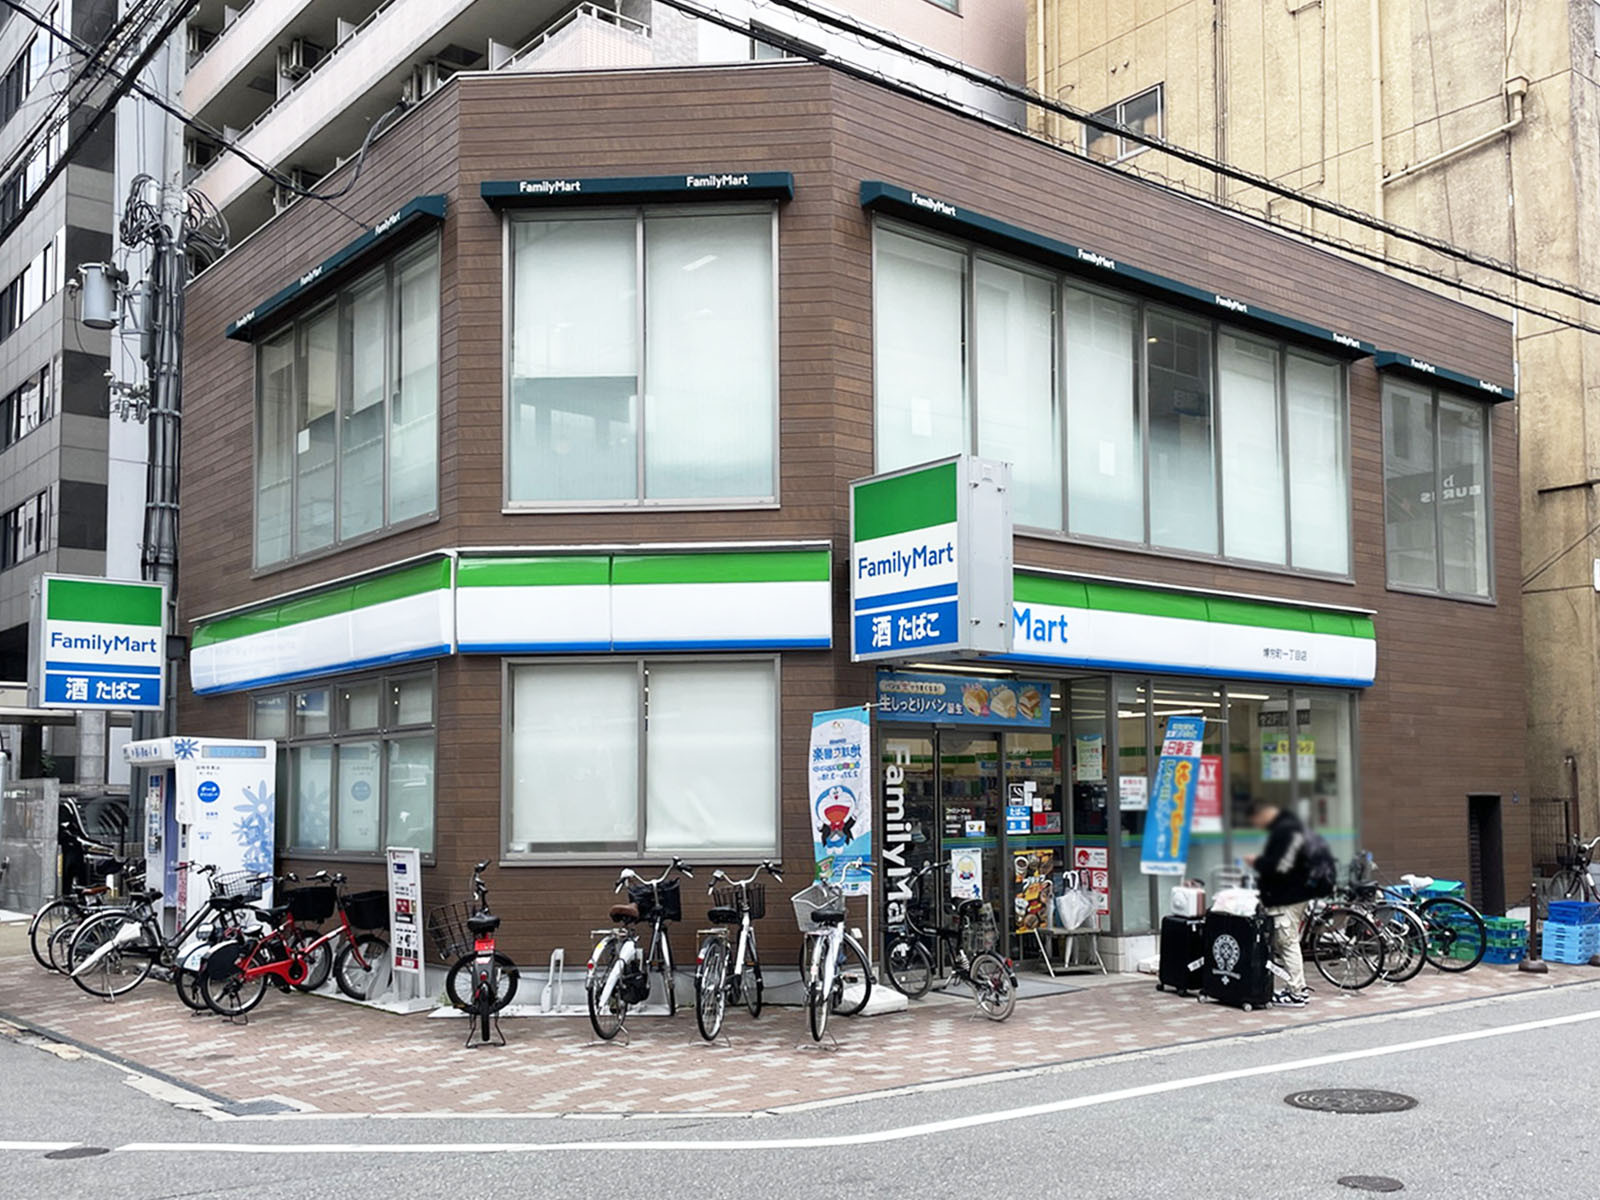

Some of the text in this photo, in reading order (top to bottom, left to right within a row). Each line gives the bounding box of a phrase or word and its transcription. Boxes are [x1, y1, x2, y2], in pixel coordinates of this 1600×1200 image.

[520, 181, 581, 194] FamilyMart
[686, 174, 749, 188] FamilyMart
[911, 193, 957, 217] FamilyMart
[1078, 248, 1116, 270] FamilyMart
[1215, 295, 1248, 313] FamilyMart
[858, 542, 954, 579] FamilyMart
[872, 612, 940, 648] 酒 たばこ
[51, 632, 157, 655] FamilyMart
[65, 677, 141, 700] 酒 たばこ
